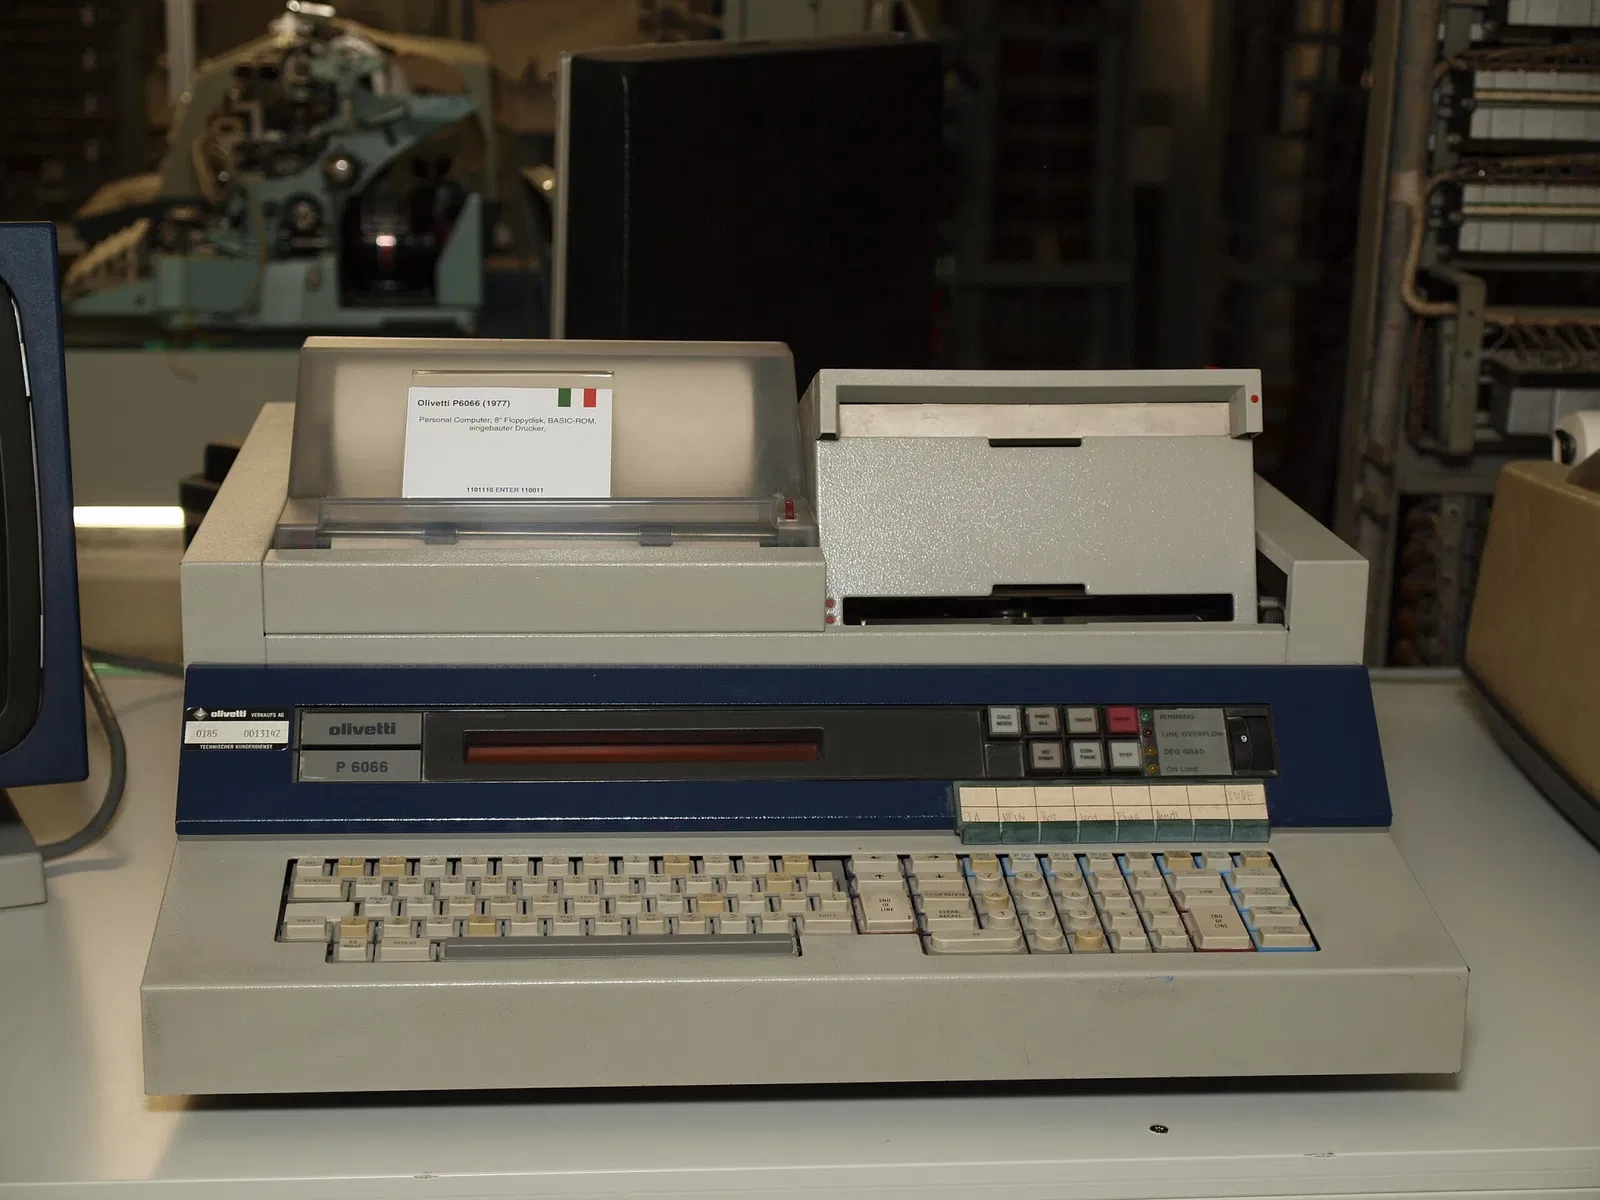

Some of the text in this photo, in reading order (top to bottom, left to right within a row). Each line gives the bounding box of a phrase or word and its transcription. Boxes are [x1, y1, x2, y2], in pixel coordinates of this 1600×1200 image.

[482, 400, 511, 408] (1977)
[211, 710, 247, 718] olivetti
[329, 722, 396, 736] olivetti
[196, 730, 218, 738] 0185
[1240, 735, 1248, 743] 9
[336, 761, 388, 773] P 6066
